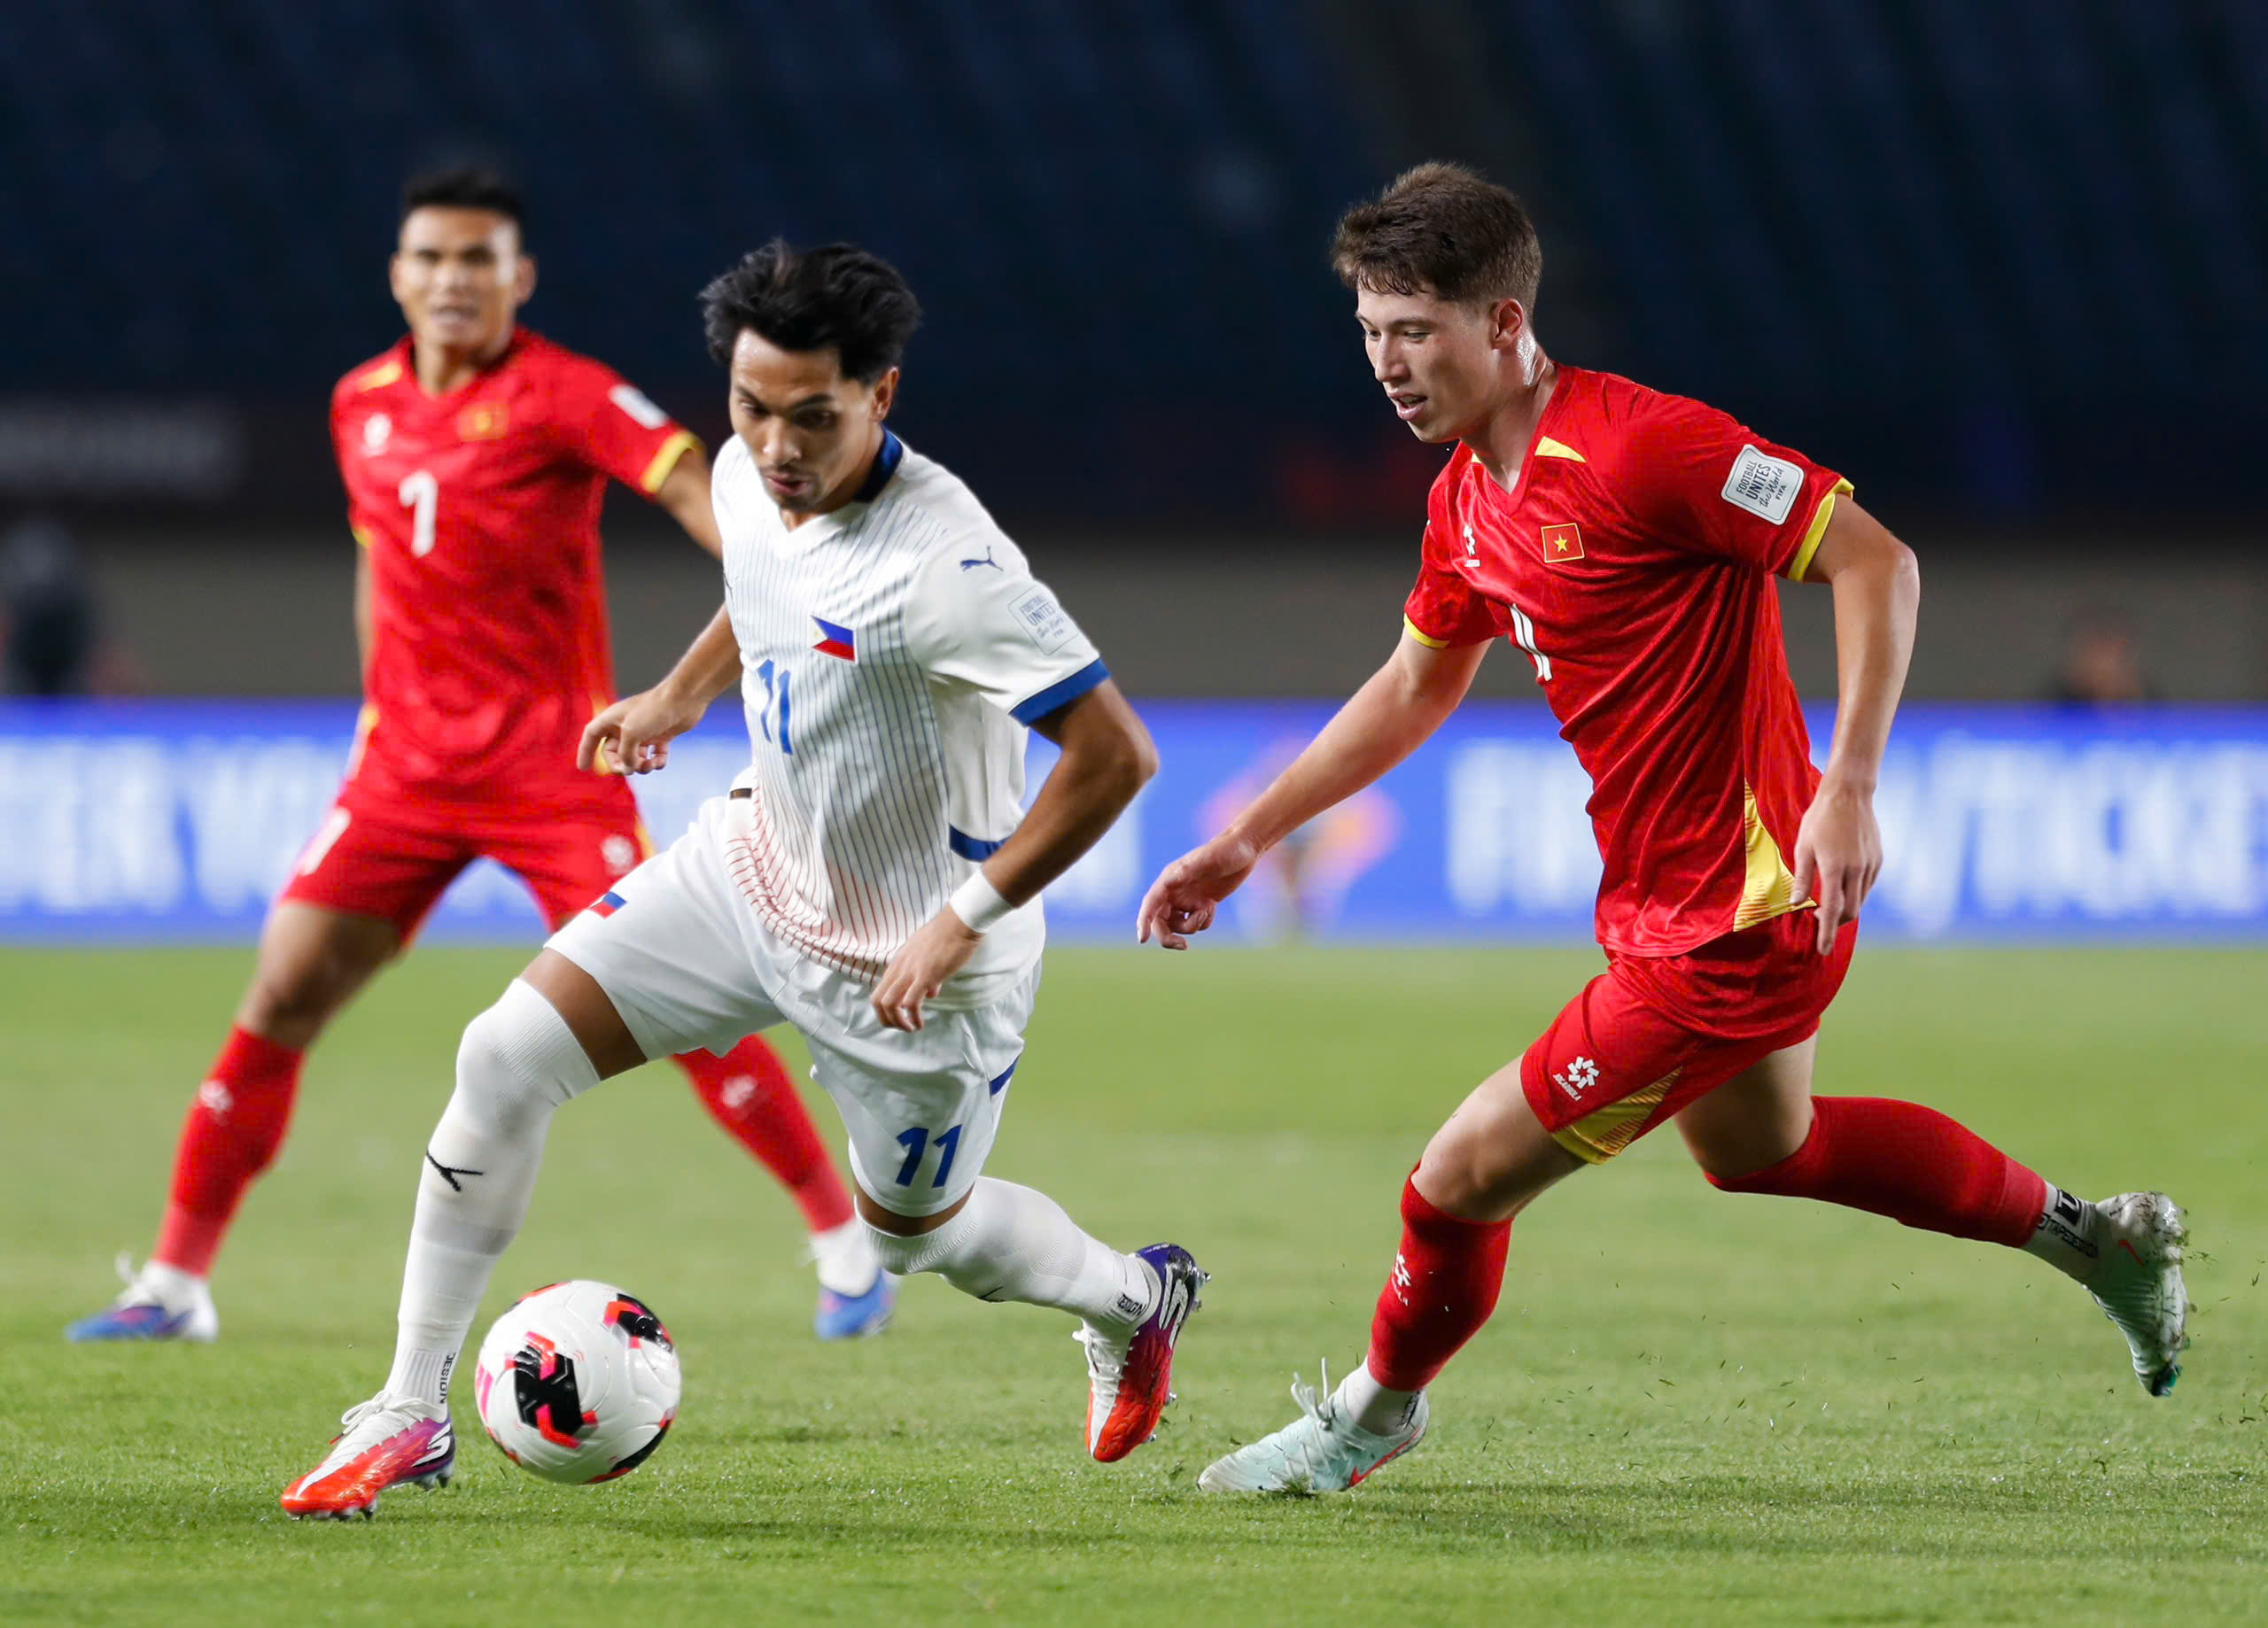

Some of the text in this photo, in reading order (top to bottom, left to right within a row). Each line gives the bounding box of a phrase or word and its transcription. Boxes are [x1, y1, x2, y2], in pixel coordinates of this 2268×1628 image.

[1736, 460, 1758, 495] FOOTBALL
[1745, 463, 1771, 500] UNITES
[1759, 466, 1784, 508] the World
[1775, 485, 1787, 500] FIFA
[1025, 601, 1057, 627] UNITES
[757, 658, 794, 756] 11
[895, 1123, 963, 1189] 11
